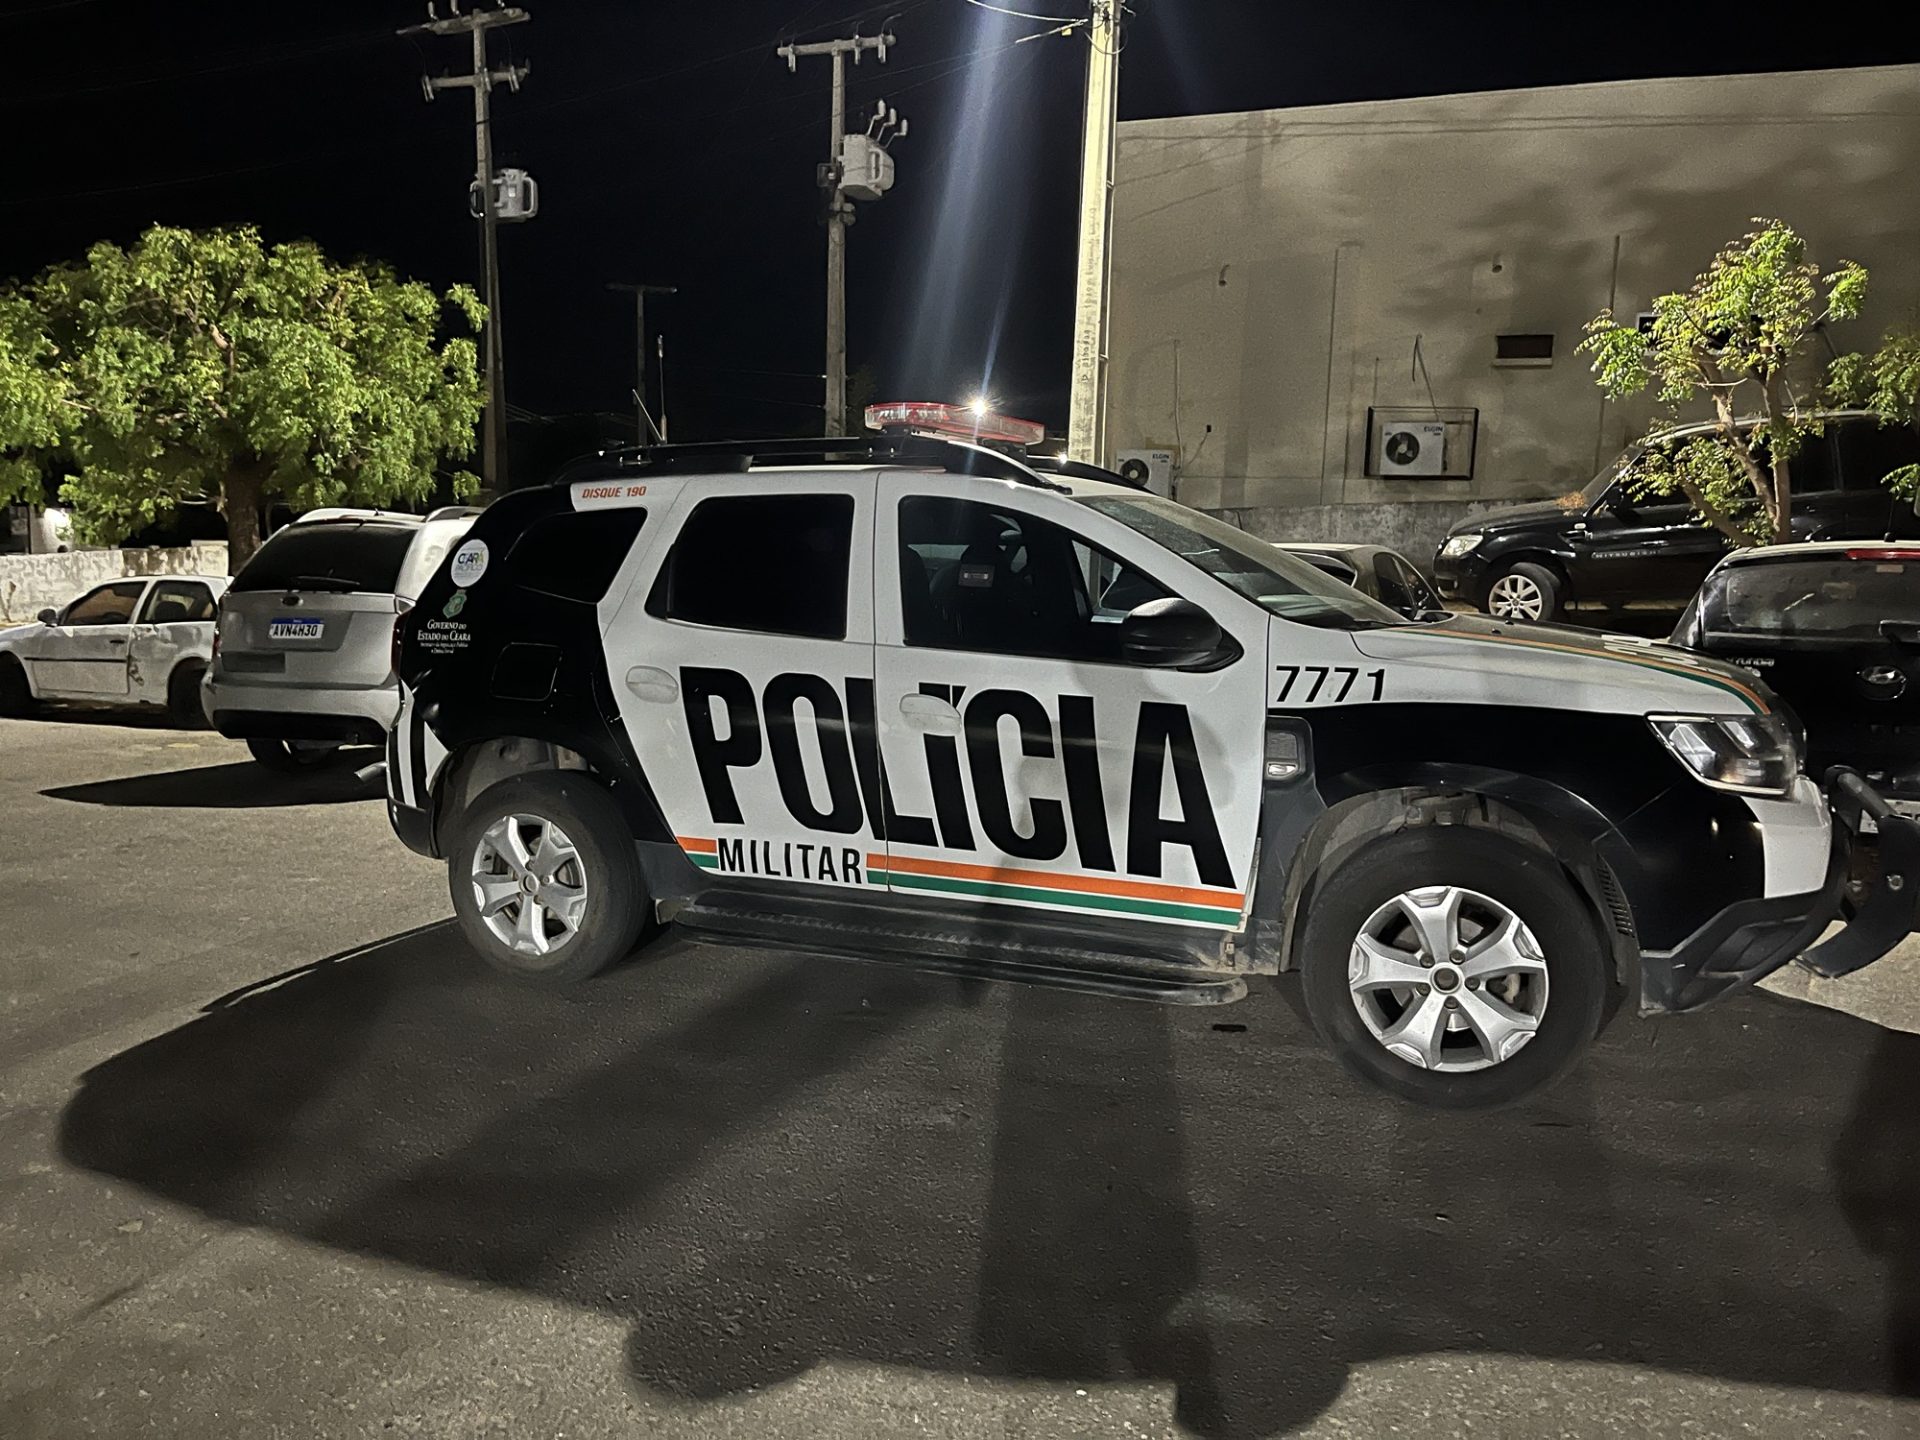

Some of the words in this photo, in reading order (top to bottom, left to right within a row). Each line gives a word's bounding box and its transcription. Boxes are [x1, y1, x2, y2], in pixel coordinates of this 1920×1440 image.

[582, 487, 622, 499] DISQUE
[627, 486, 647, 497] 190
[1276, 665, 1385, 702] 7771
[679, 666, 1237, 889] POLÍCIA
[717, 837, 862, 884] MILITAR
